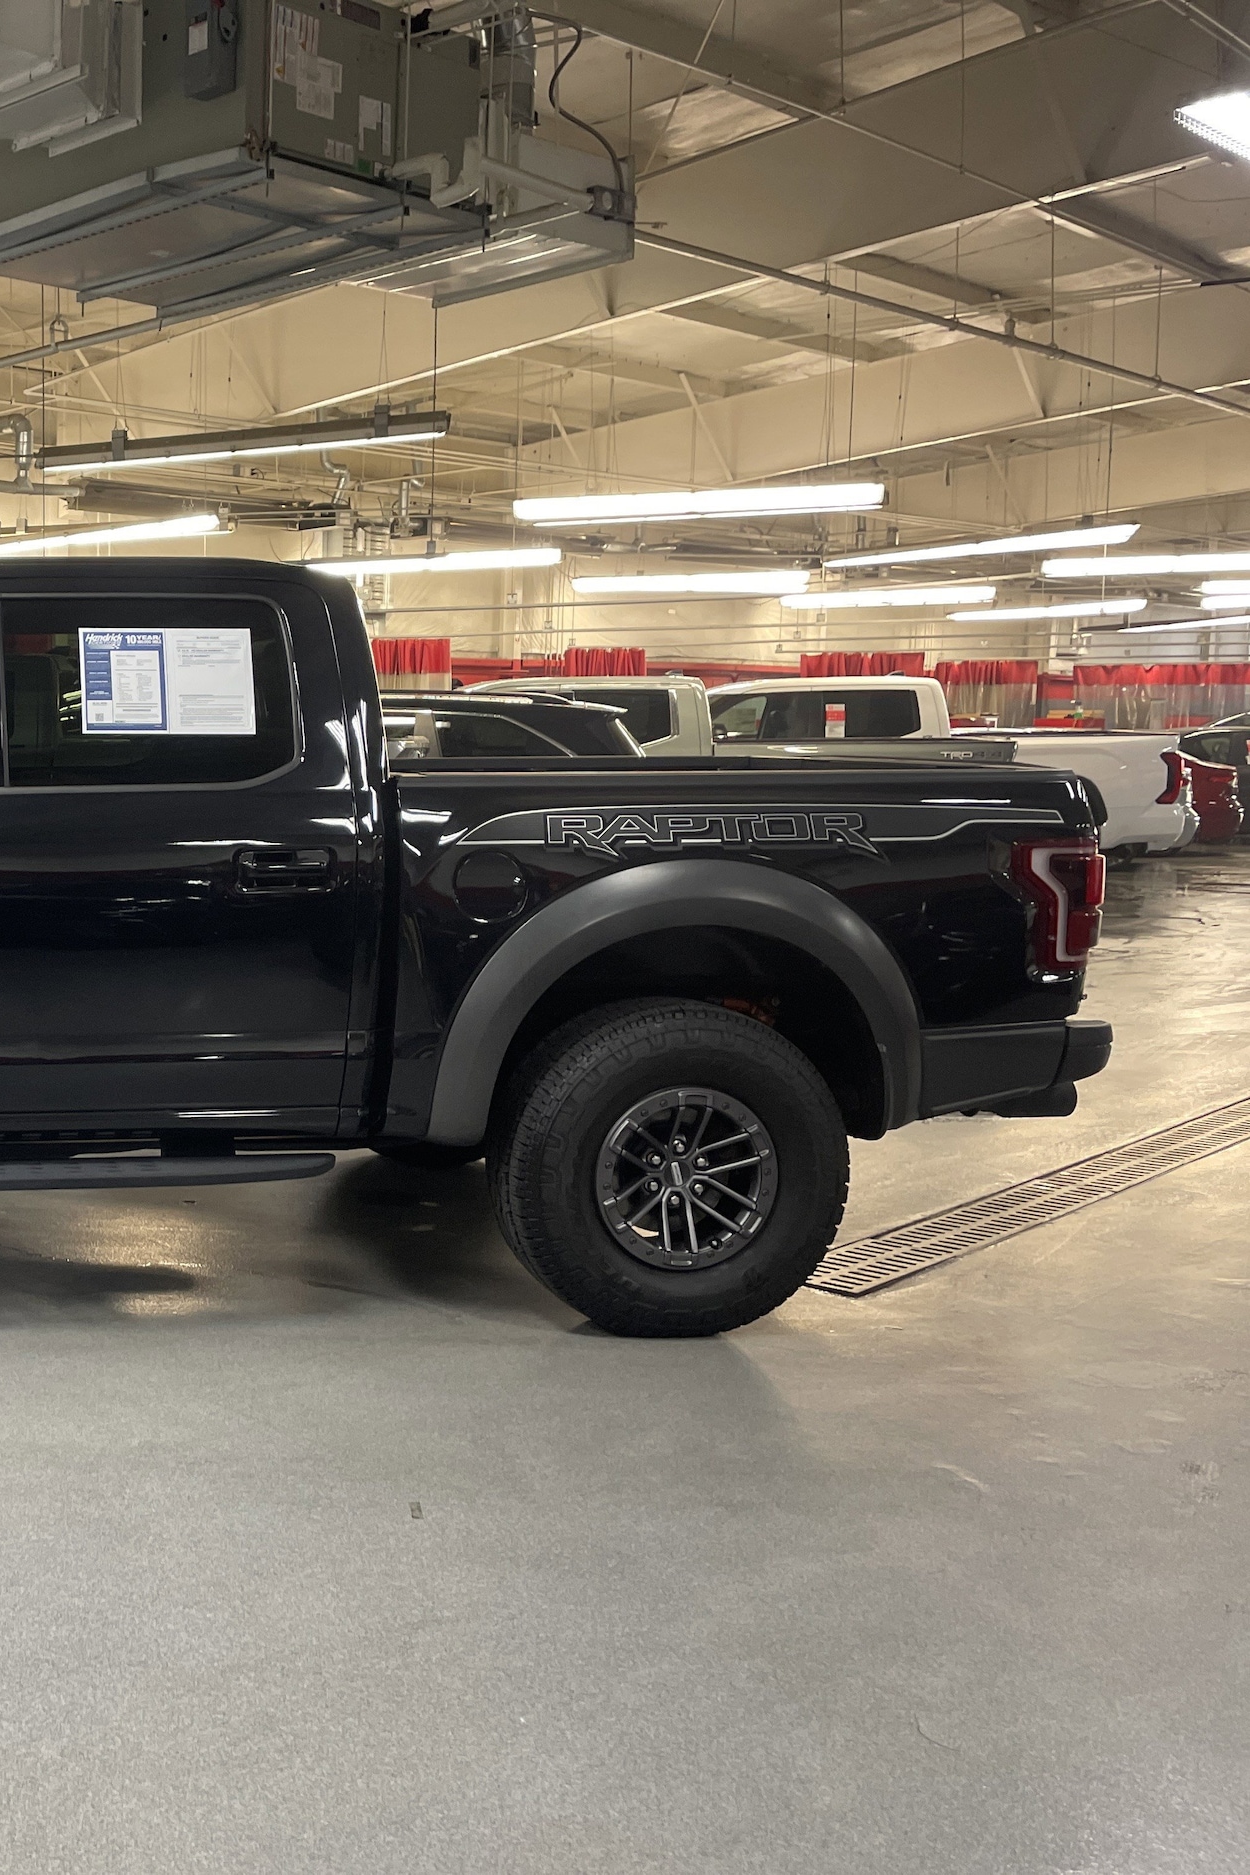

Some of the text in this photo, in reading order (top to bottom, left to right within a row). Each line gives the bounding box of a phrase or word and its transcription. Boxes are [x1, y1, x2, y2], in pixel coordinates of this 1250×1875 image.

[85, 633, 123, 645] Hendrick
[125, 634, 137, 644] 10
[940, 751, 973, 760] TRD
[545, 812, 880, 857] RAPTOR
